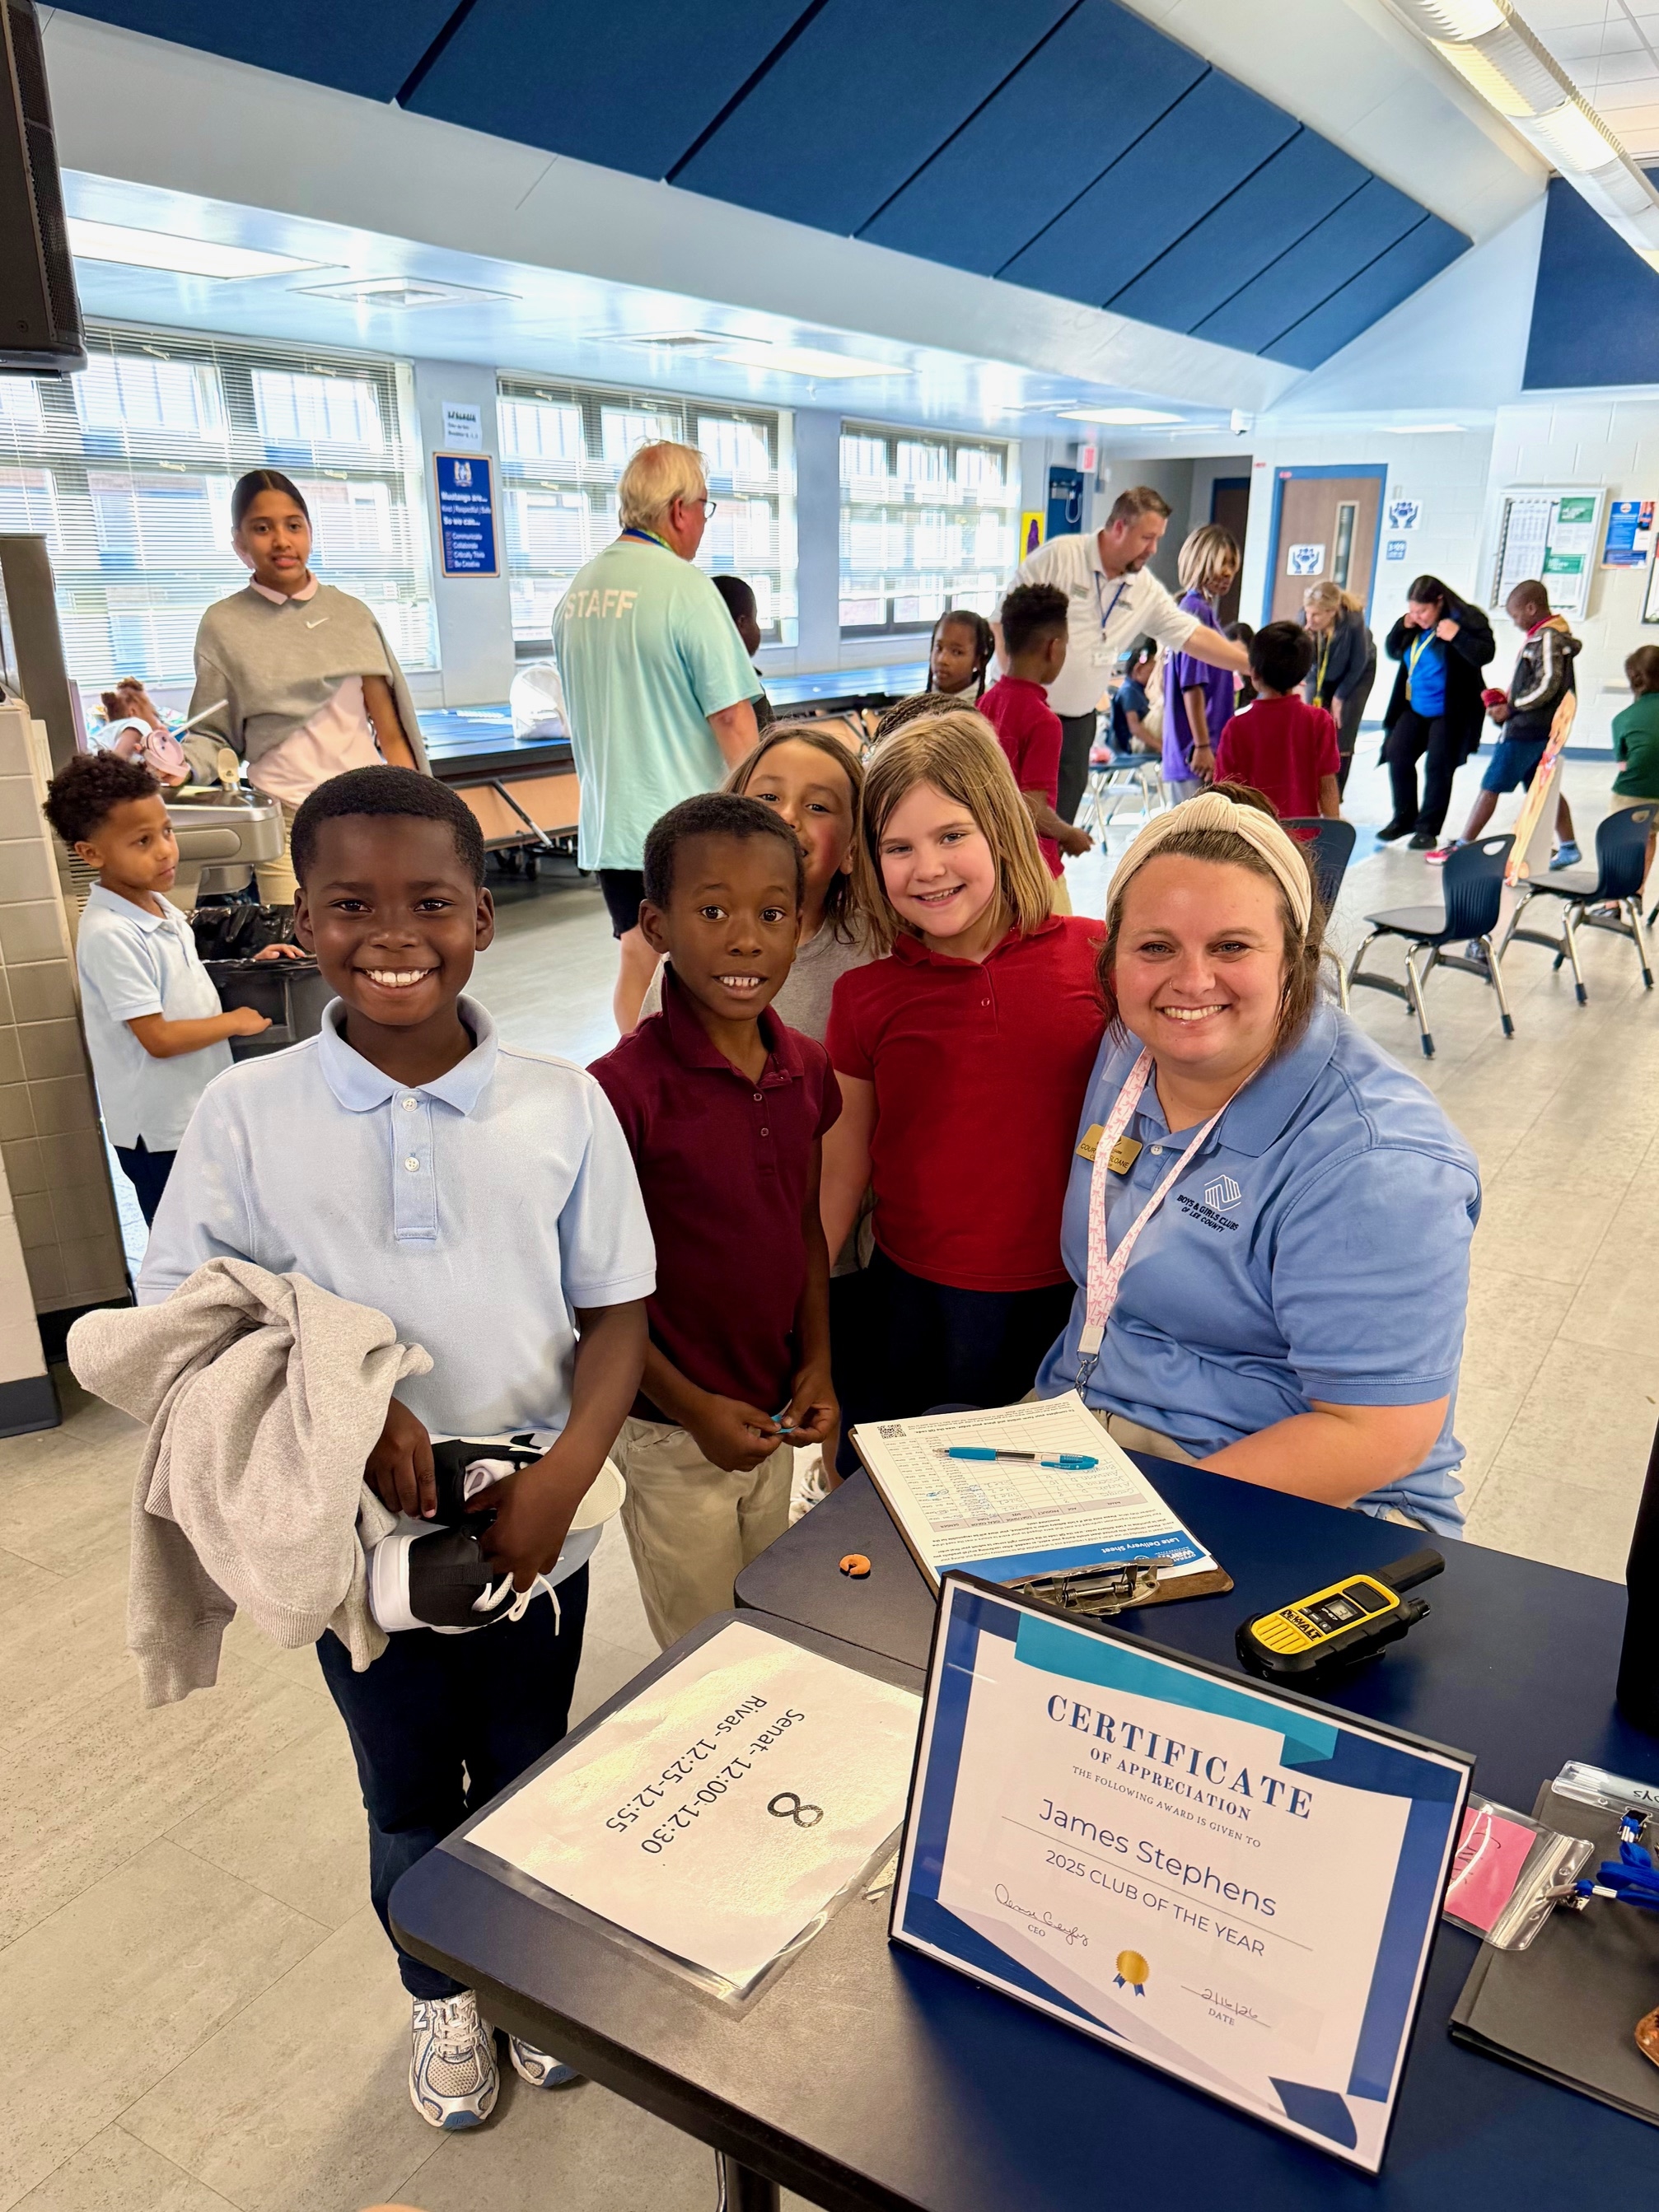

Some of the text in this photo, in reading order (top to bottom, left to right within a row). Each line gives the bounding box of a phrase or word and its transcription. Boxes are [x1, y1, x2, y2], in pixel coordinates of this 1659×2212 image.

[564, 589, 638, 619] STAFF
[1177, 1195, 1195, 1207] BOYS
[1199, 1206, 1220, 1220] GIRLS
[1219, 1217, 1239, 1230] CLUBS
[1189, 1211, 1201, 1219] LEE
[1201, 1217, 1226, 1232] COUNTY
[1100, 1545, 1127, 1553] Sheet
[1124, 1539, 1161, 1550] Delivery
[605, 1695, 768, 1833] Rivas- 12:25-12:55
[1048, 1694, 1313, 1820] CERTIFICATE
[640, 1708, 805, 1855] Senat- 12:00-12:30
[1091, 1748, 1251, 1821] OF APPRECIATION
[767, 1791, 824, 1827] 8
[1073, 1766, 1261, 1848] THE FOLLOWING AWARD IS GIVEN TO
[1039, 1799, 1277, 1916] James Stephens
[1045, 1850, 1265, 1957] 2025 CLUB OF THE YEAR
[1027, 1924, 1046, 1937] CEO
[1208, 2008, 1235, 2026] DATE
